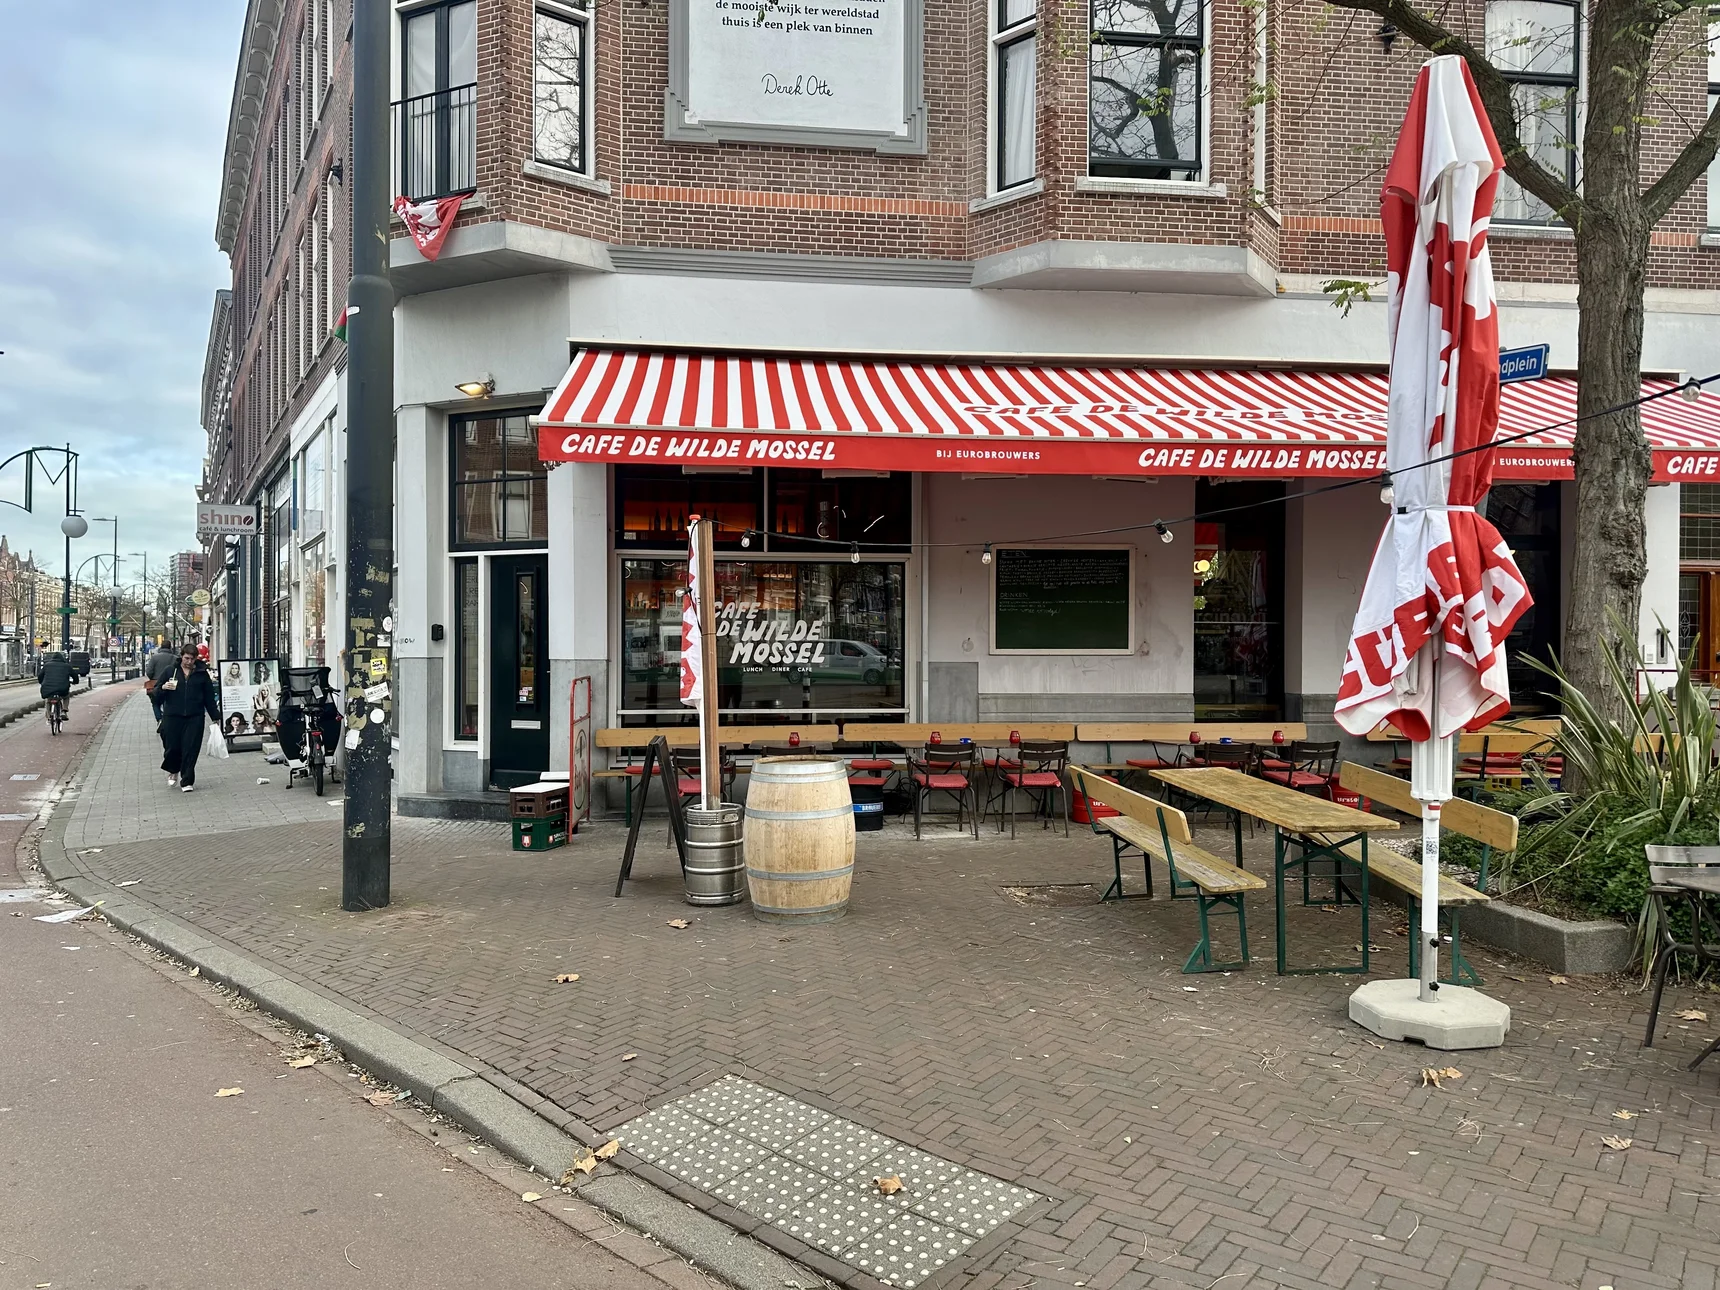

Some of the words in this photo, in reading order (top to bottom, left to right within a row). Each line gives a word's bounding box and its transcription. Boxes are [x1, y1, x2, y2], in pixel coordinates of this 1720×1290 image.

[716, 0, 728, 9] de
[732, 2, 774, 12] mooiste
[777, 4, 802, 16] wijk
[804, 7, 818, 15] ter
[822, 8, 879, 19] wereldstad
[722, 16, 750, 27] thuis
[752, 18, 761, 28] is
[764, 22, 783, 30] een
[786, 21, 810, 33] plek
[813, 24, 832, 32] van
[835, 22, 873, 35] binnen
[762, 73, 803, 96] Derek
[806, 75, 834, 97] Otte
[1499, 356, 1537, 376] dplein
[964, 405, 1074, 414] CAFE
[1089, 405, 1140, 413] DE
[1156, 408, 1288, 419] WILDE
[1302, 411, 1388, 421] MOS
[561, 434, 625, 454] CAFE
[628, 436, 661, 456] DE
[665, 437, 741, 458] WILDE
[746, 439, 836, 460] MOSSEL
[936, 450, 952, 458] BIJ
[956, 450, 1040, 460] EUROBROUWERS
[1138, 448, 1195, 467] CAFE
[1198, 449, 1228, 468] DE
[1231, 450, 1301, 469] WILDE
[1306, 450, 1387, 469] MOSSEL
[1667, 456, 1718, 474] CAFE
[716, 620, 741, 637] DE
[742, 620, 823, 642] WILDE
[729, 643, 825, 664] MOSSEL
